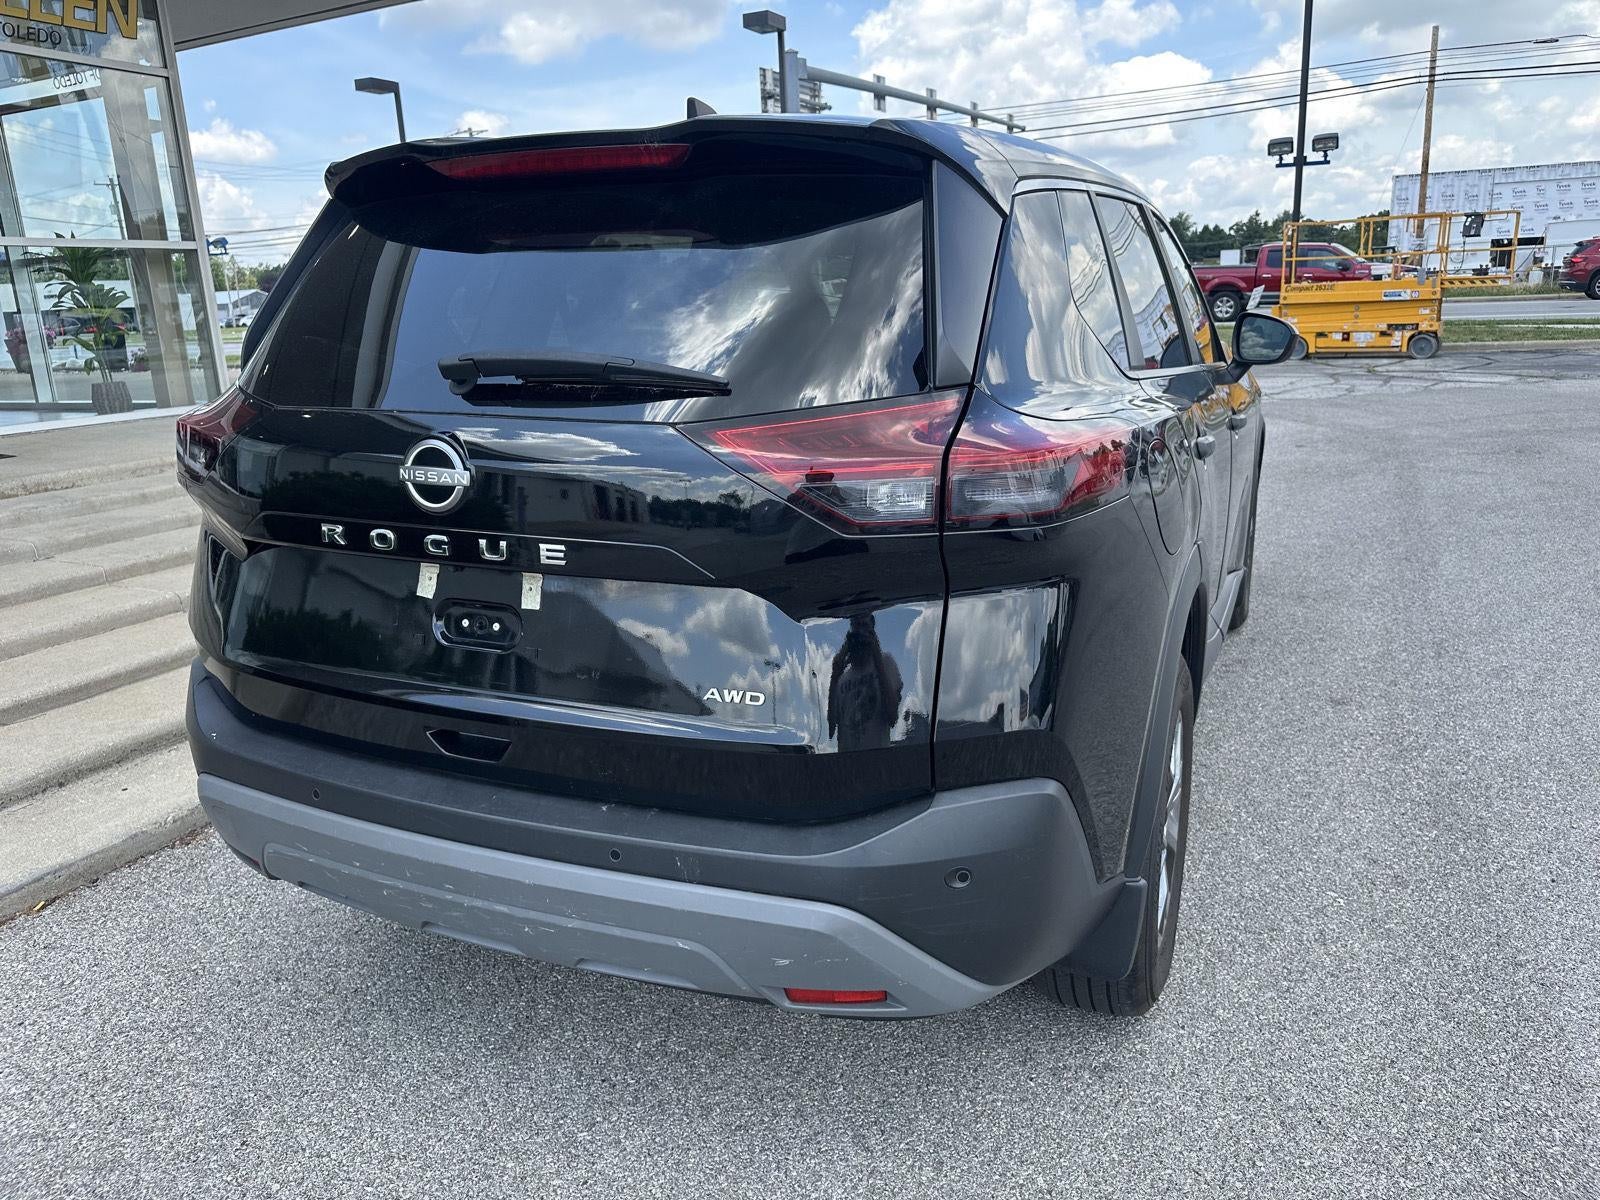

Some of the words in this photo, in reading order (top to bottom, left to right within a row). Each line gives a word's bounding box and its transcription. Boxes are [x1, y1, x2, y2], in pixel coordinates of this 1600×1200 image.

[0, 21, 62, 45] OLEDO
[400, 467, 468, 485] NISSAN
[321, 522, 567, 566] ROGUE
[703, 687, 766, 706] AWD
